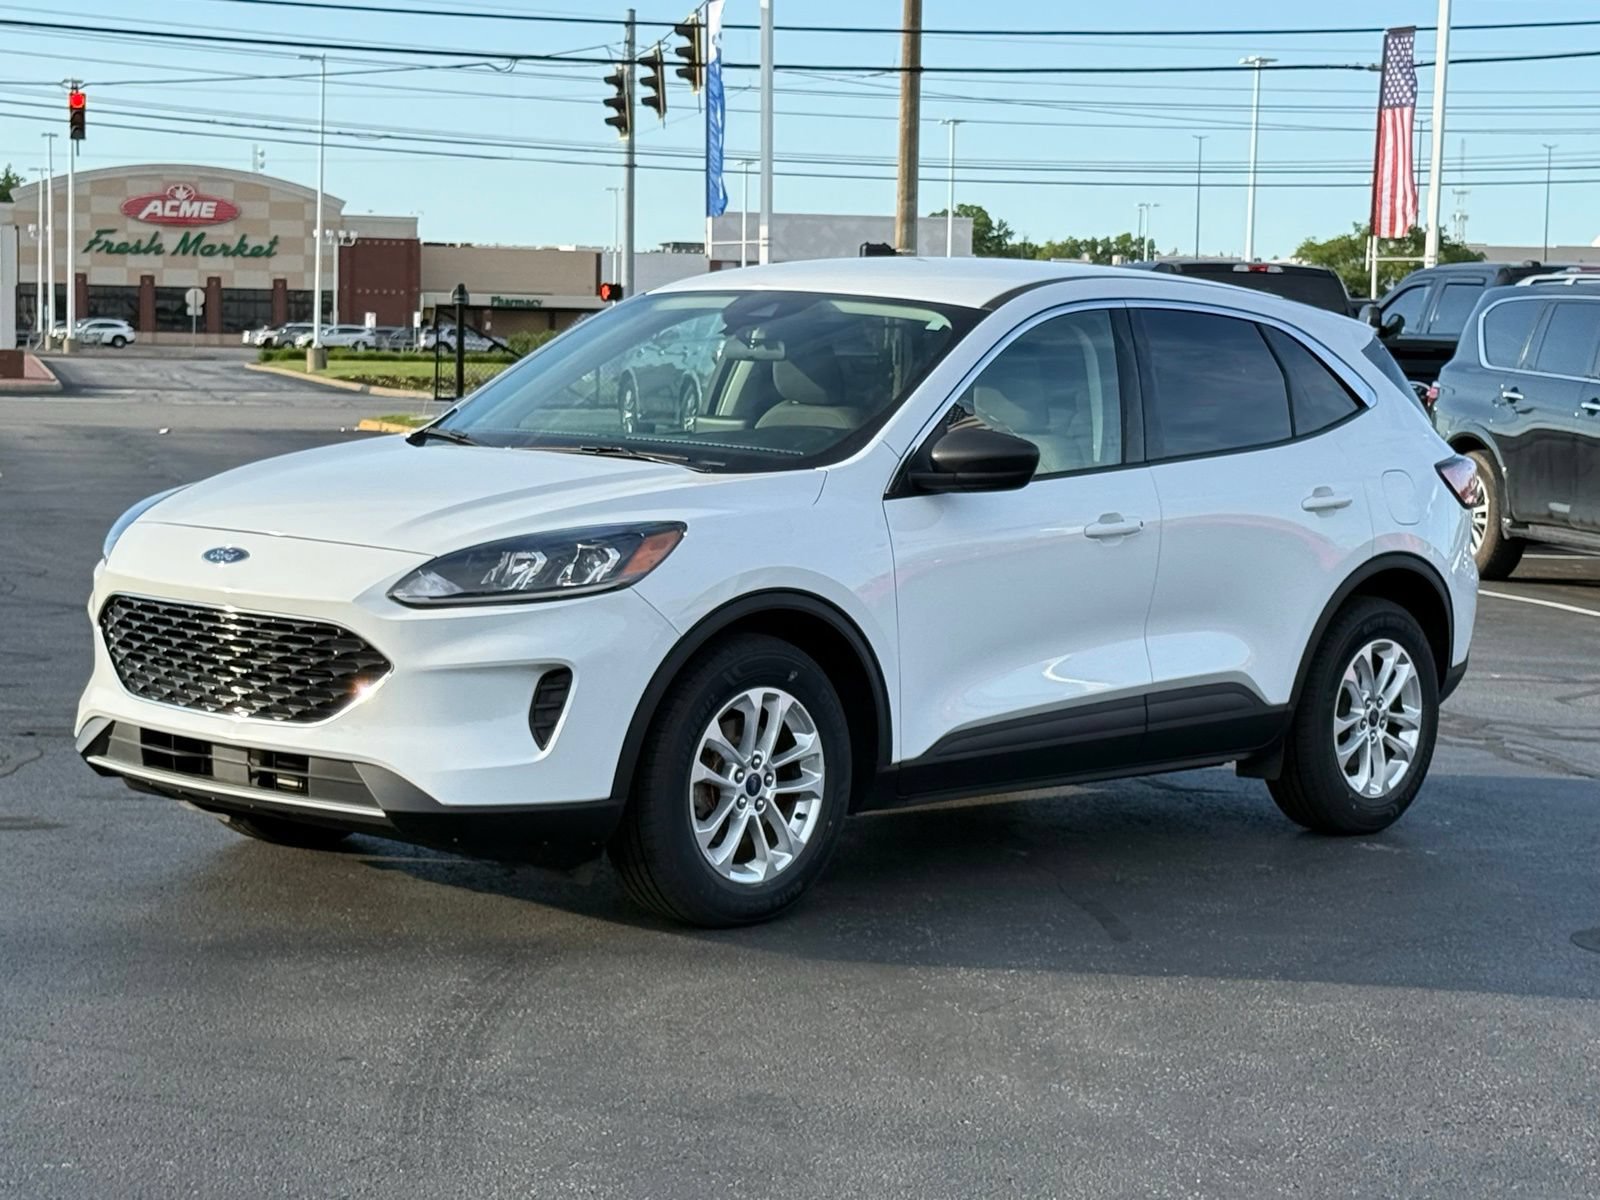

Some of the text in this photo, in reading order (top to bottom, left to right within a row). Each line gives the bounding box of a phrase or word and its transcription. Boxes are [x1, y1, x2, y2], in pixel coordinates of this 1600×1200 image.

[138, 200, 218, 219] ACME
[82, 229, 279, 258] Fresh Market
[490, 295, 543, 308] Pharmacy
